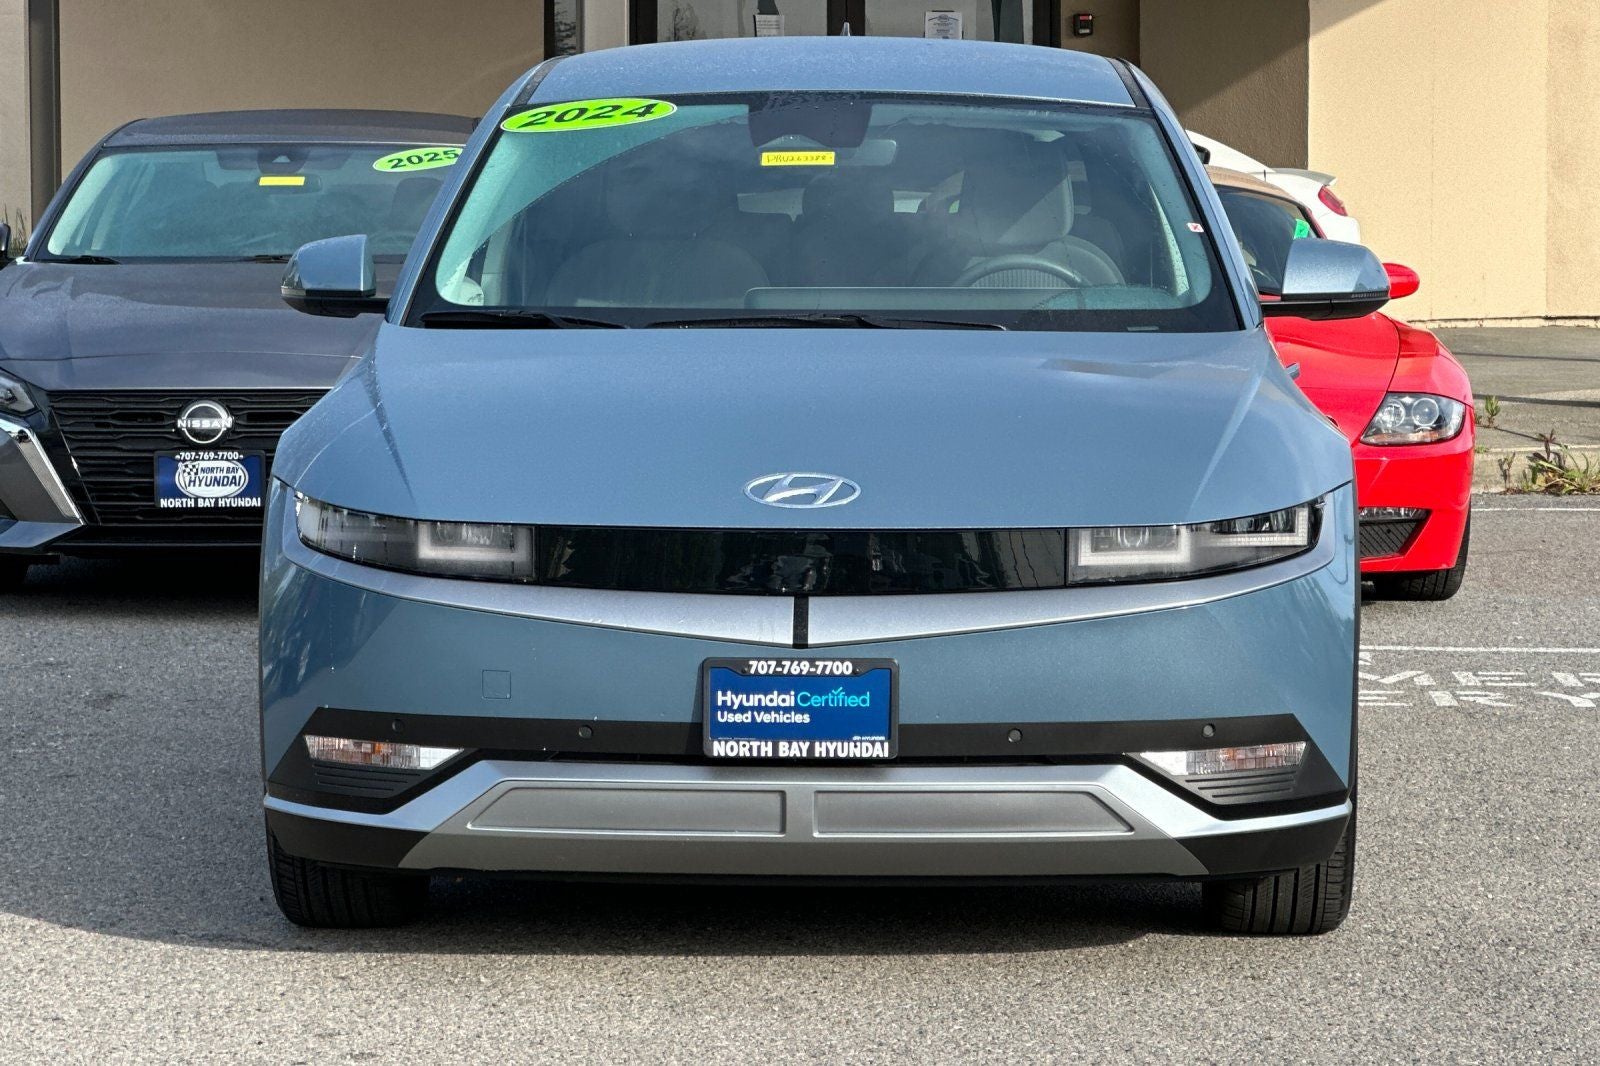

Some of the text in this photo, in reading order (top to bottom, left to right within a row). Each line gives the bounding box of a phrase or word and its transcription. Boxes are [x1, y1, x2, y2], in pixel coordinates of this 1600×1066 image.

[516, 103, 659, 129] 2024
[388, 150, 460, 169] 2025
[177, 418, 233, 428] NISSAN
[179, 452, 239, 460] 707-769-7700
[200, 466, 240, 474] NORTH BAY
[188, 475, 242, 487] HYUNDAI
[160, 497, 261, 508] NORTH BAY HYUNDAI
[748, 660, 853, 675] 707-769-7700
[717, 687, 870, 709] Hyundai Certified
[717, 711, 810, 723] Used Vehicles
[713, 741, 889, 758] NORTH BAY HYUNDAI
